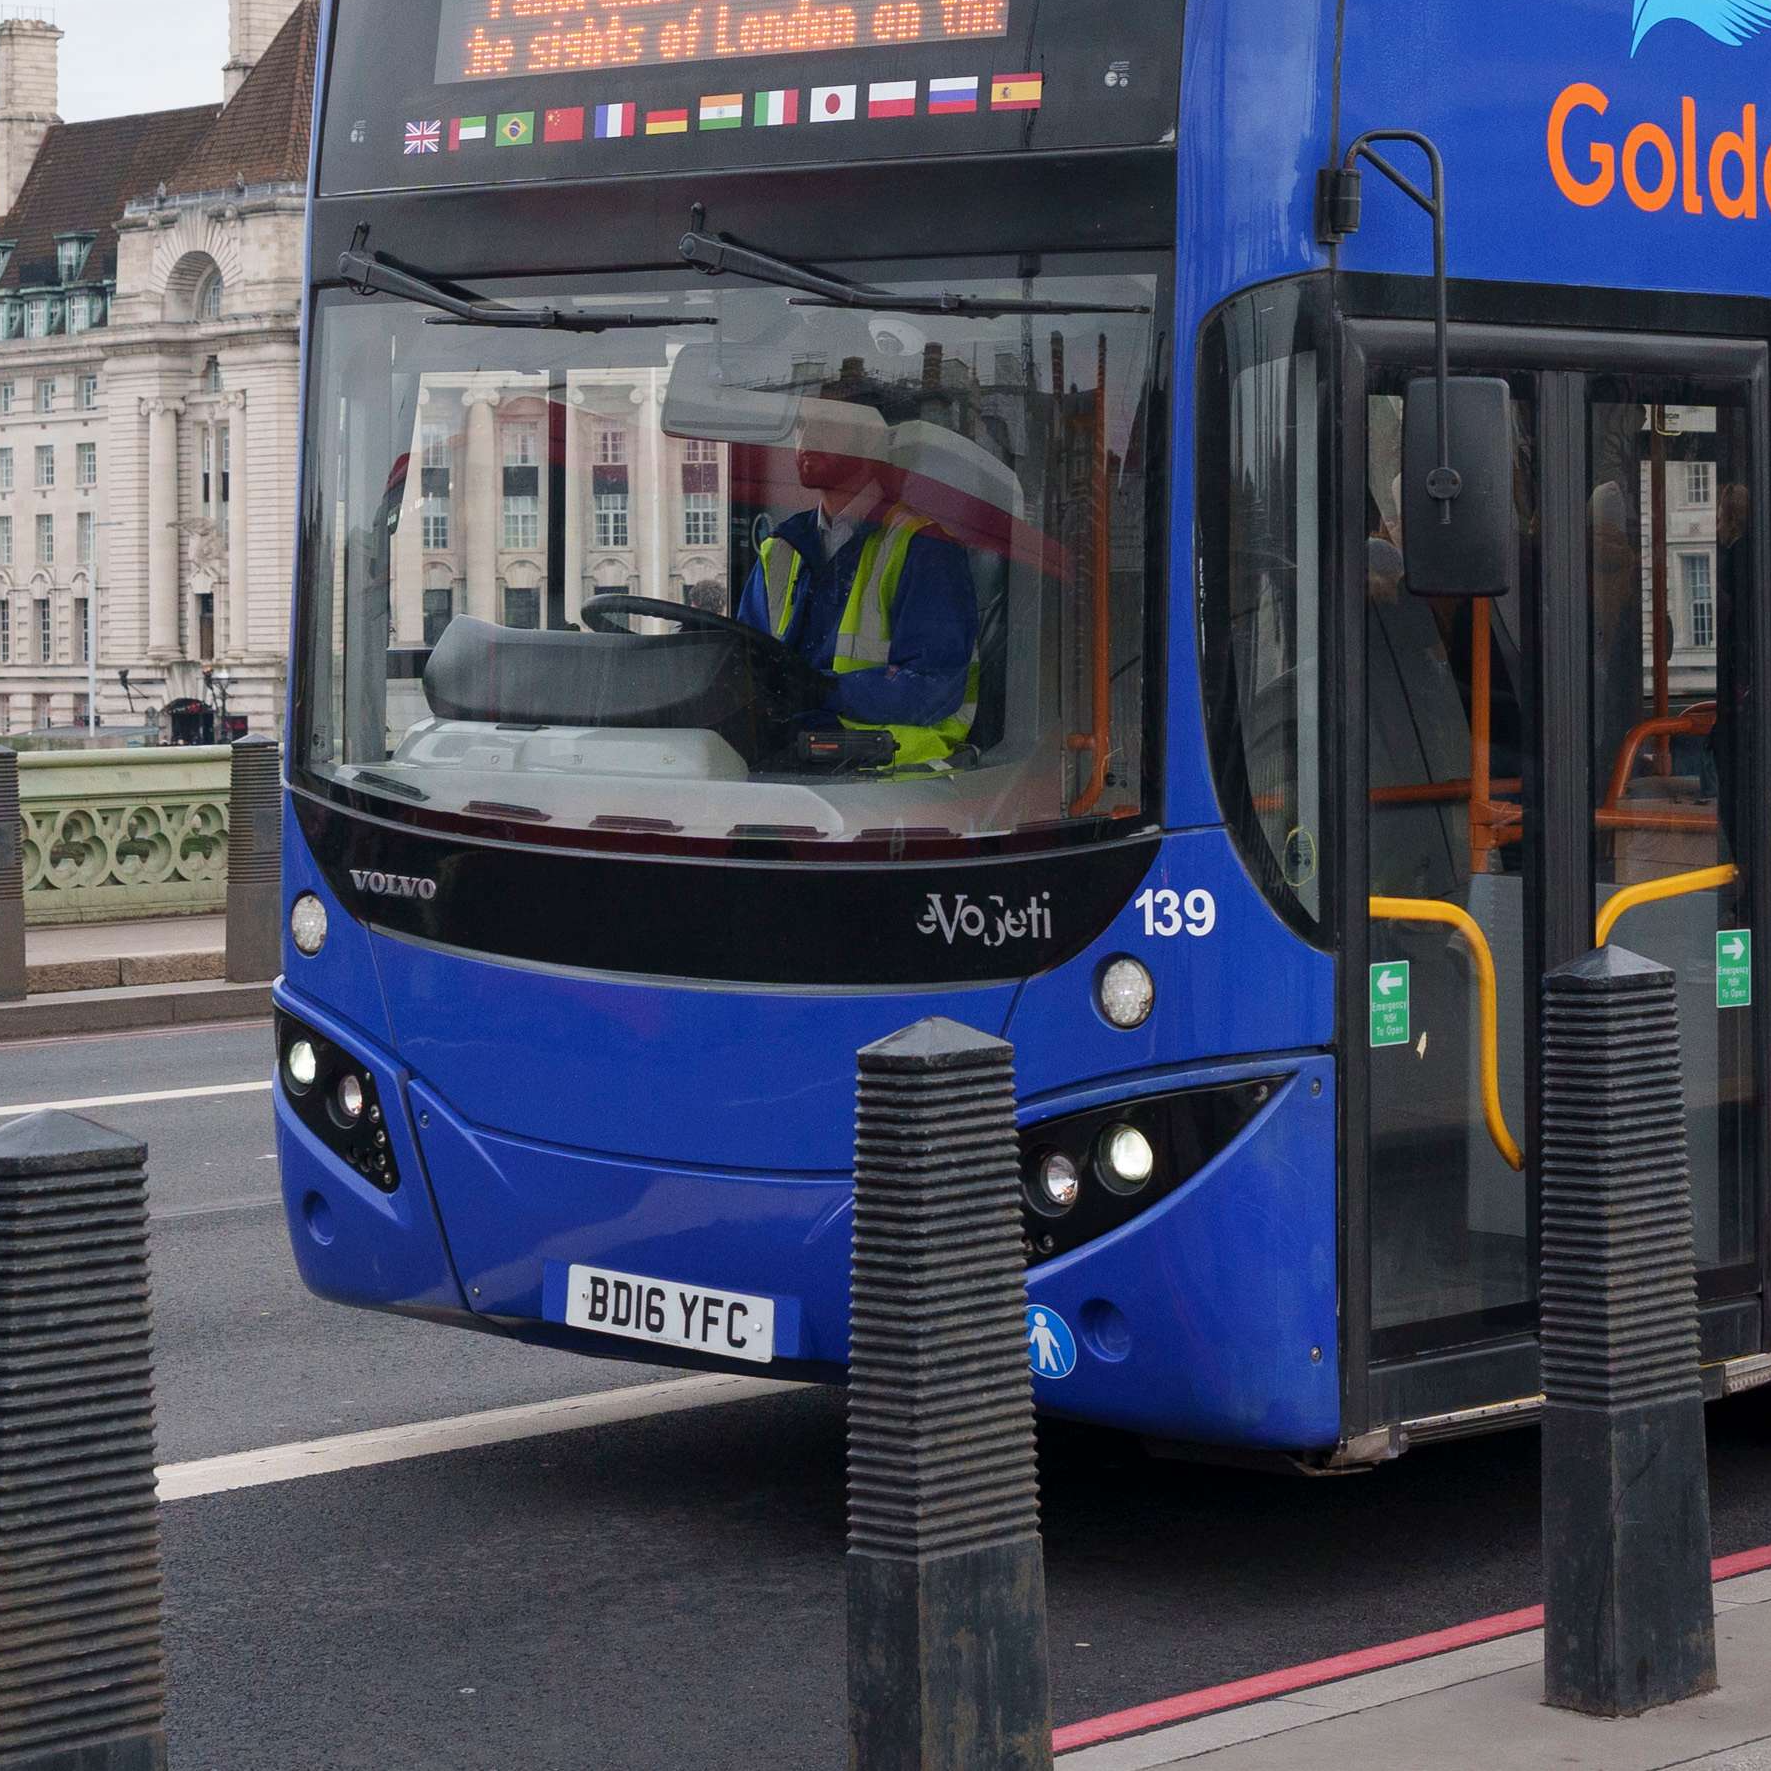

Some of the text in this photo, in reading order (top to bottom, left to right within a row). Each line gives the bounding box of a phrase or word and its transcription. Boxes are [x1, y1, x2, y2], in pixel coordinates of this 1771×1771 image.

[528, 14, 645, 73] sights
[659, 6, 703, 59] of
[872, 1, 922, 42] on
[349, 869, 437, 900] VOLVO
[1135, 888, 1216, 937] 139
[1376, 1024, 1403, 1036] To Open
[588, 1276, 749, 1349] BD16 YFC
